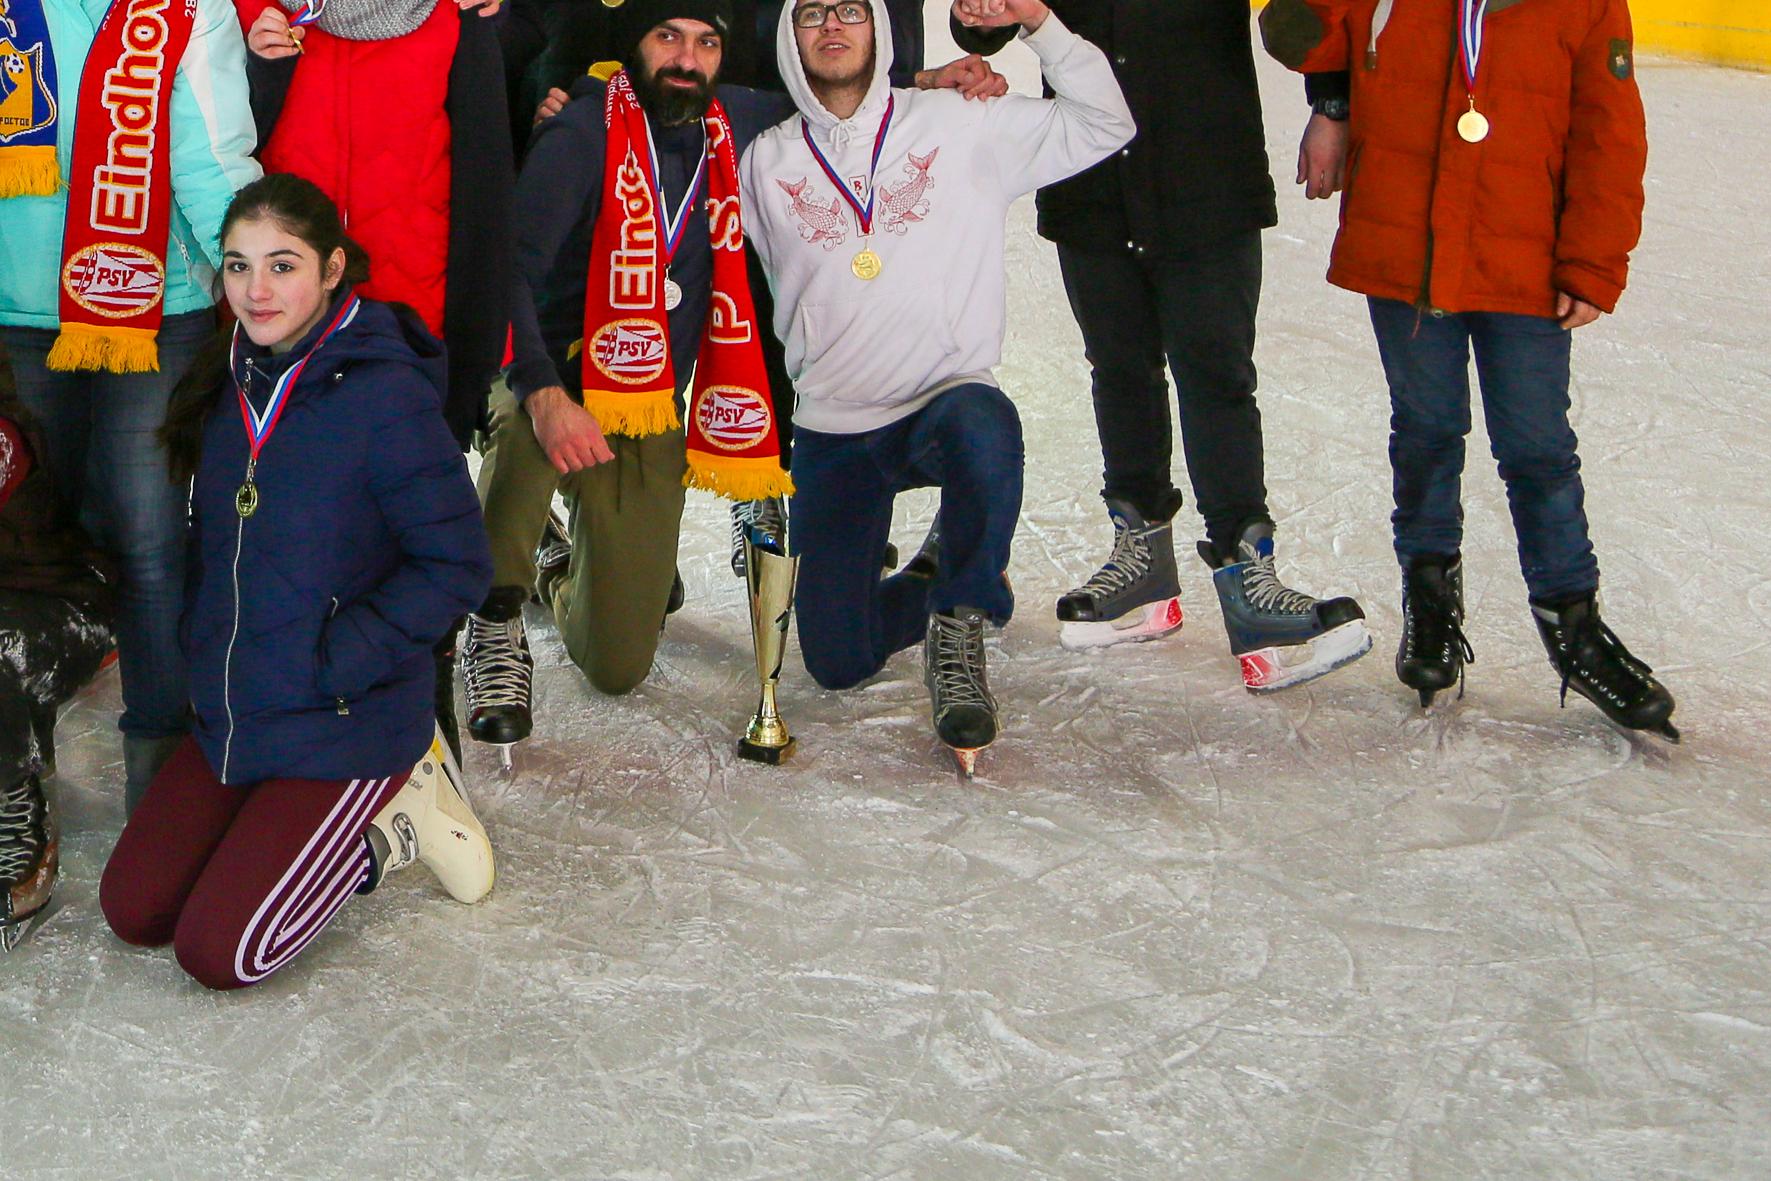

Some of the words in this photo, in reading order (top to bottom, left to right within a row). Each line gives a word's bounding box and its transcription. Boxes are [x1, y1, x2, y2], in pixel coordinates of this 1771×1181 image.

[96, 265, 137, 287] PSV
[617, 338, 652, 356] PSV
[713, 406, 745, 425] PSV
